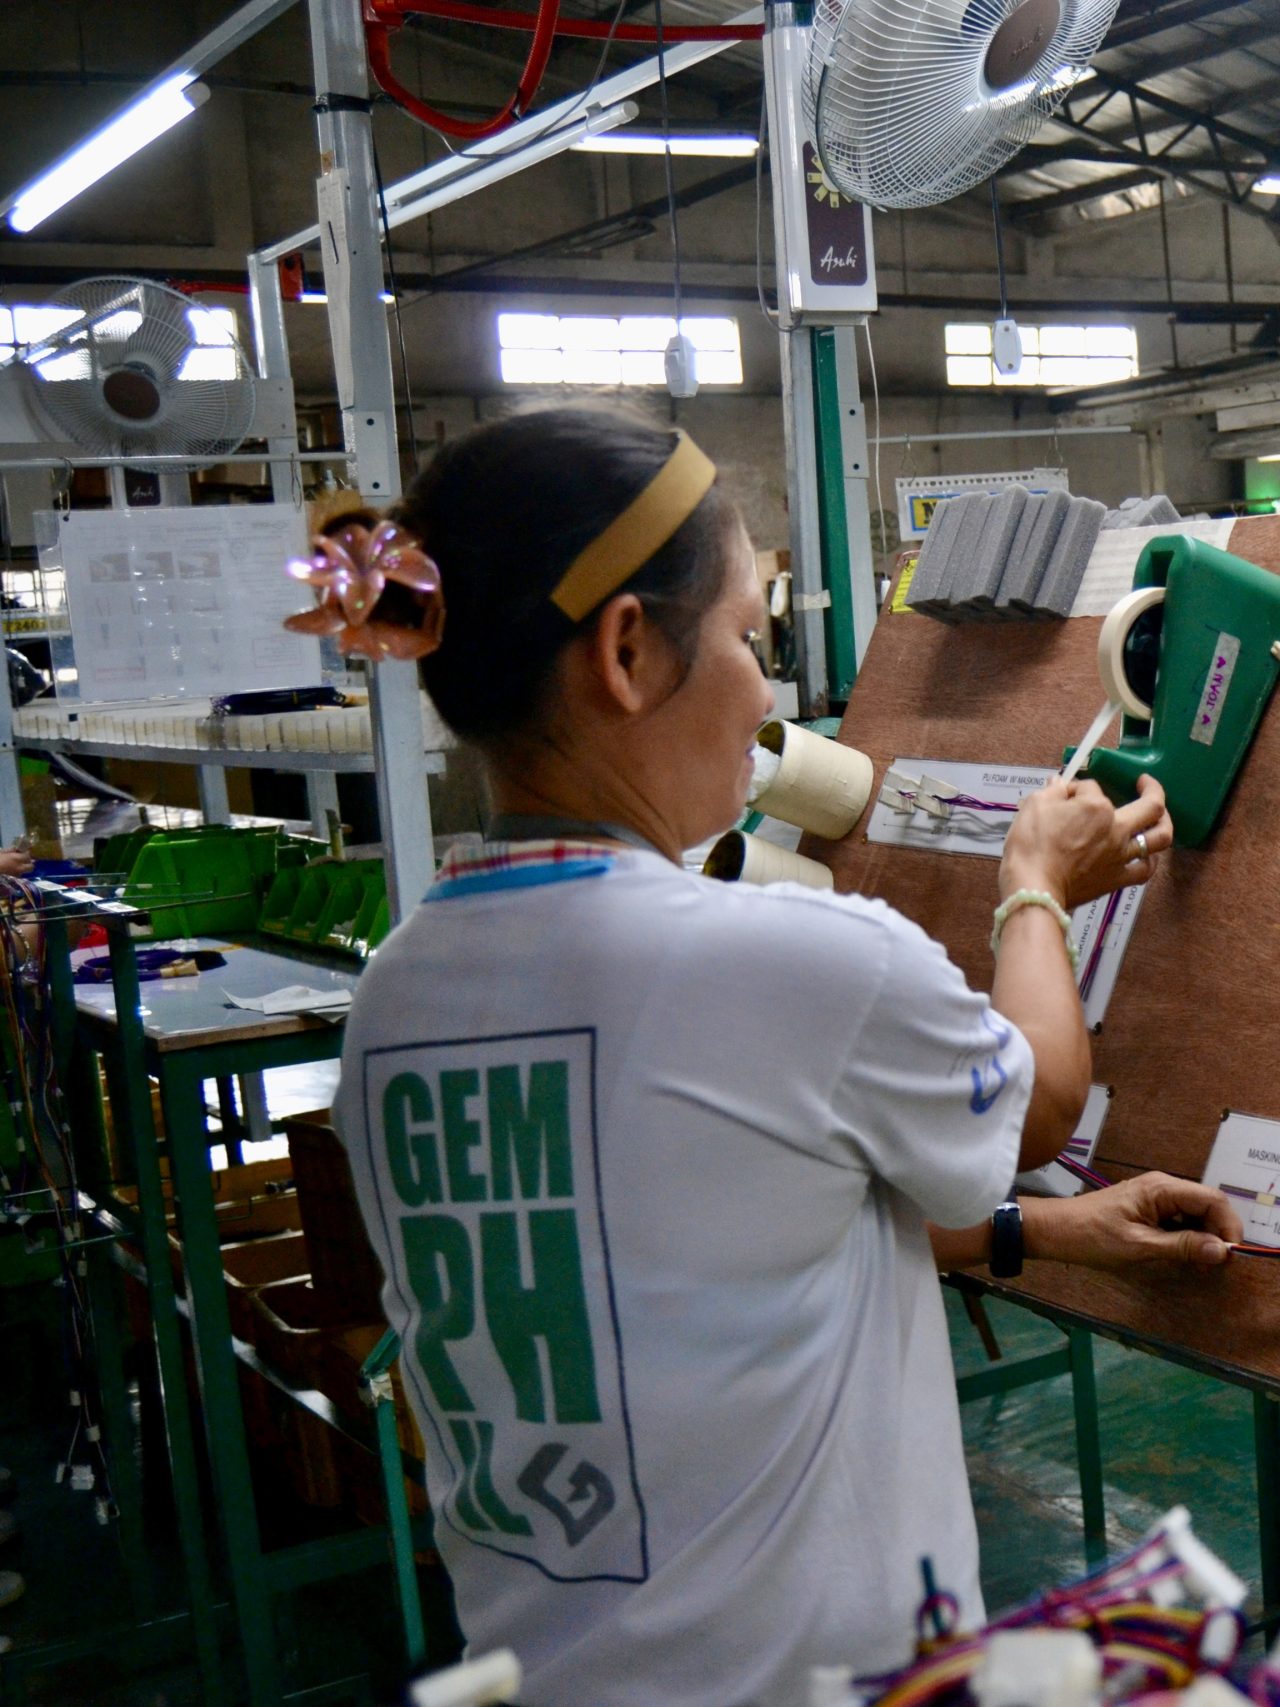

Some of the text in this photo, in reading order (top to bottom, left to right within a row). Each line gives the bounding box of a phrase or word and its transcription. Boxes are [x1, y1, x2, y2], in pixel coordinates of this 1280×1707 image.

[991, 773, 1008, 784] FOAM
[1017, 774, 1045, 786] MASKING
[1122, 886, 1138, 916] 18.00
[383, 1060, 575, 1208] GEM
